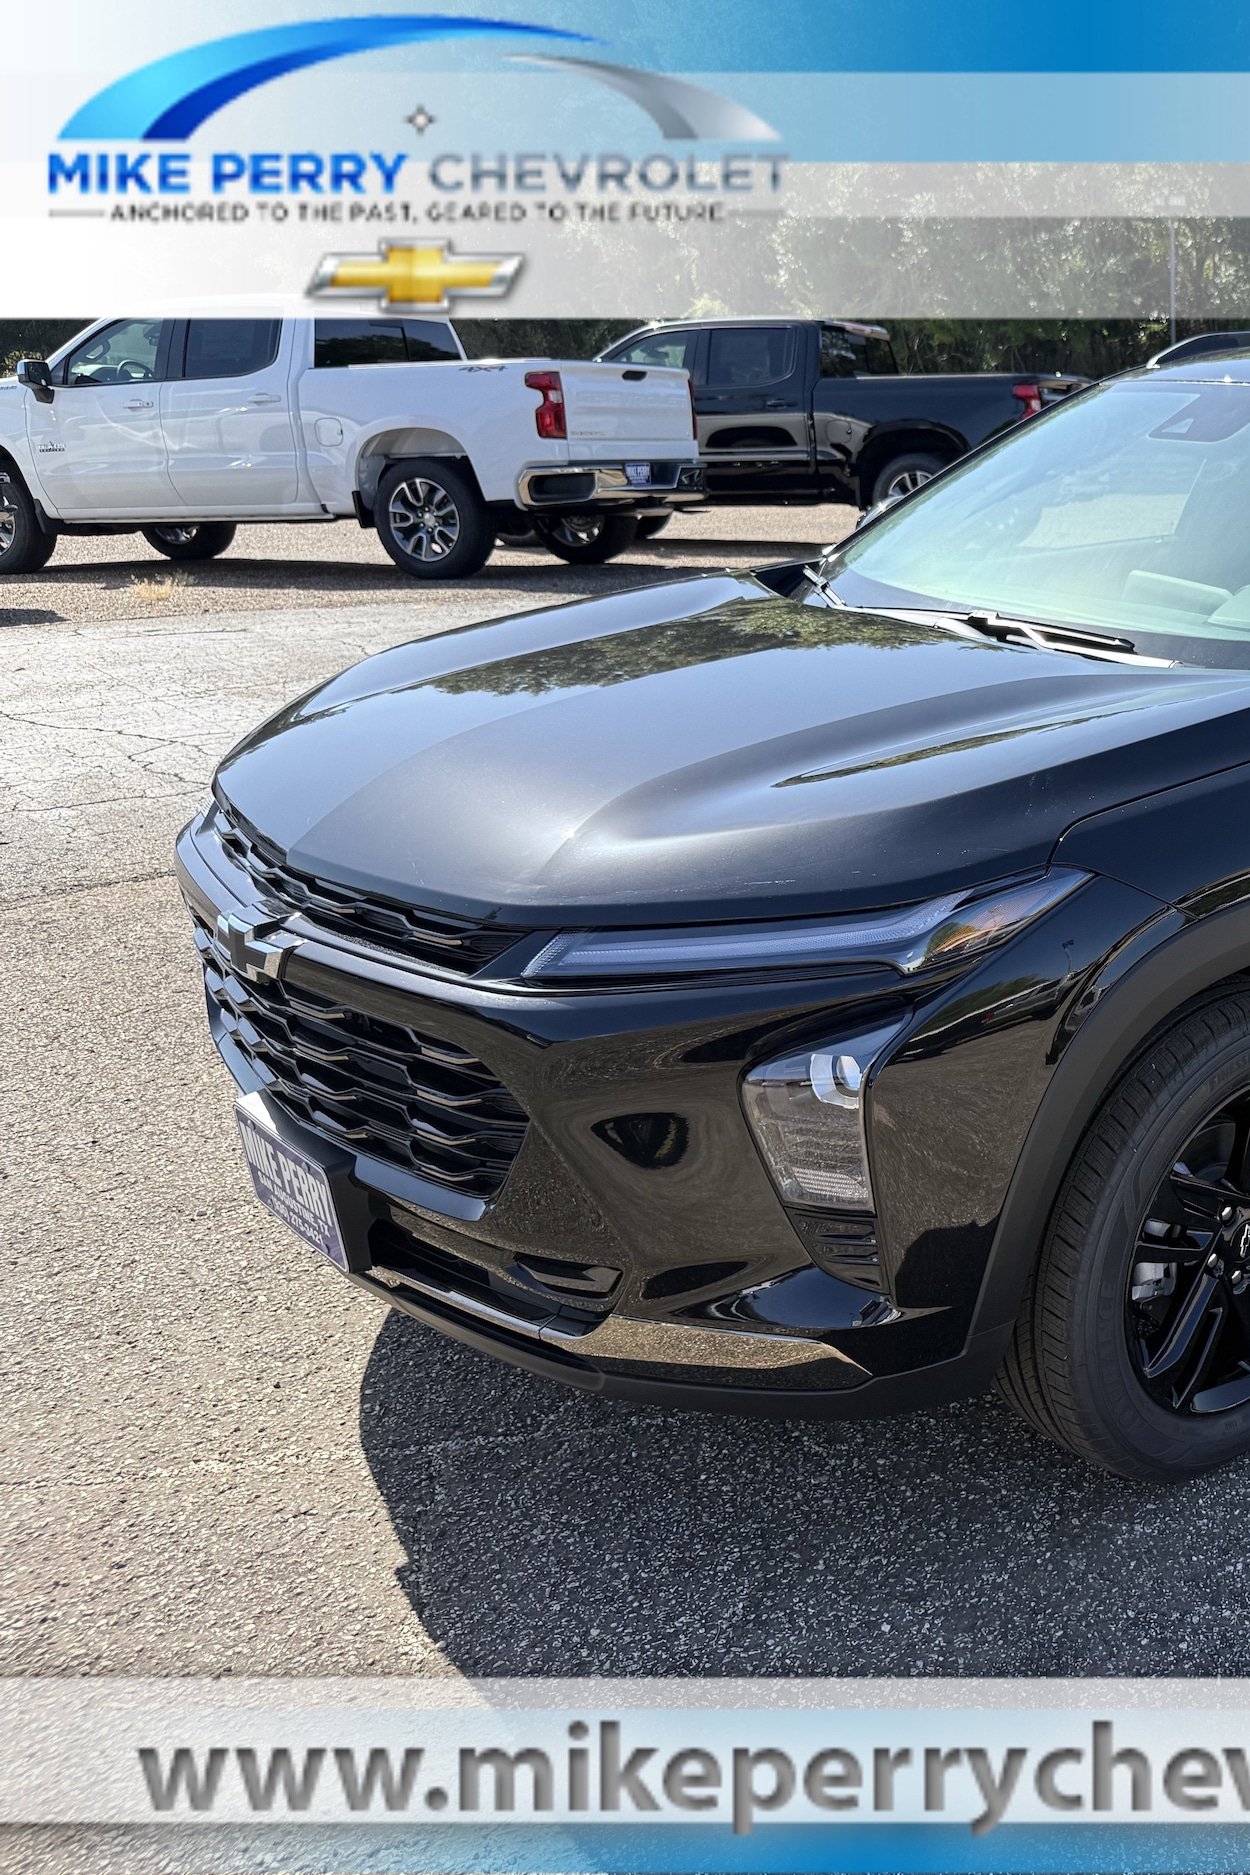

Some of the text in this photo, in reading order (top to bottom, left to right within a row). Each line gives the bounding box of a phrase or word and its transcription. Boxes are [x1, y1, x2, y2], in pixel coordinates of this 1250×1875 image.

[239, 1120, 334, 1227] MIKE PERRY
[258, 1170, 274, 1192] SAN
[318, 1219, 331, 1238] TX
[289, 1211, 324, 1246] 275-3421
